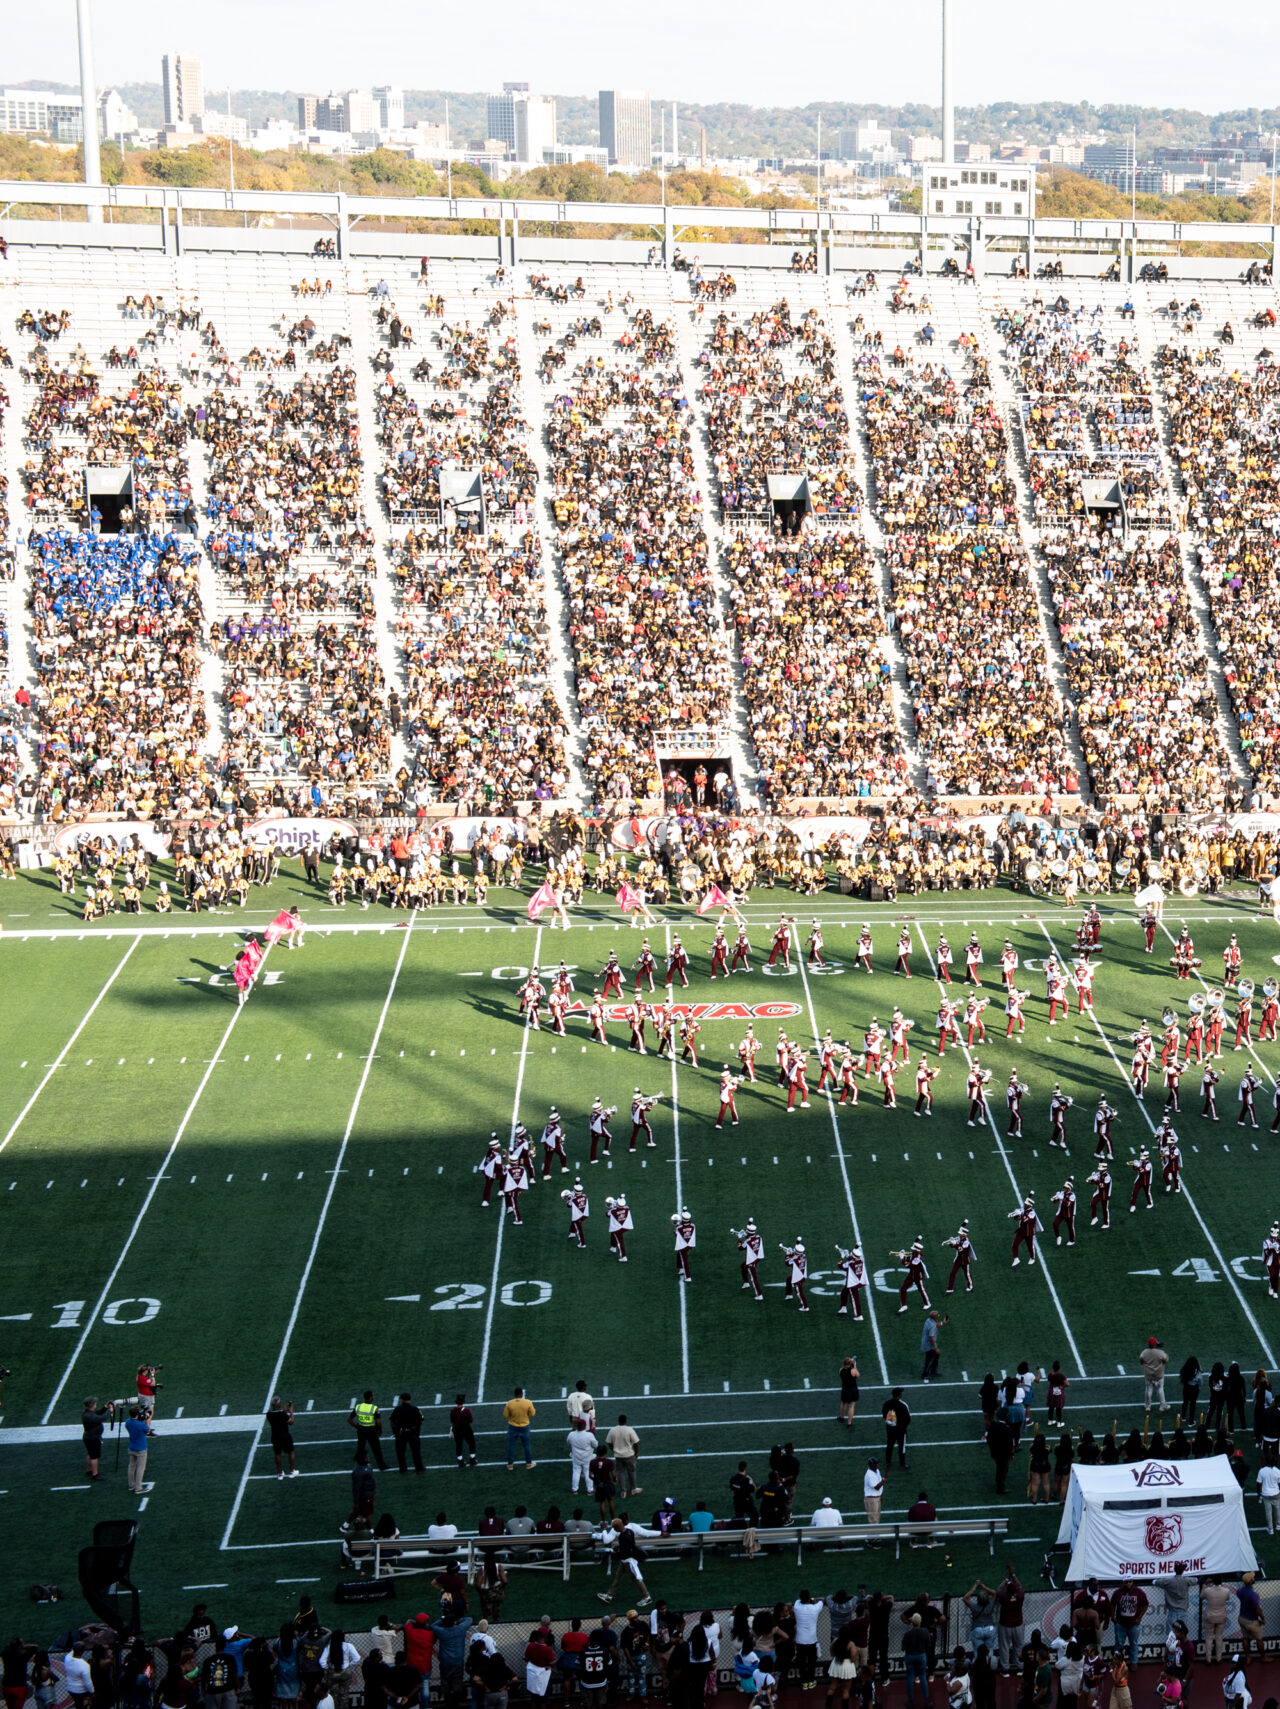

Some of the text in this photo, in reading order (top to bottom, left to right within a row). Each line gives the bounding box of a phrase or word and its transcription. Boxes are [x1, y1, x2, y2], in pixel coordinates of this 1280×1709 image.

[265, 827, 321, 847] Shipt
[429, 1280, 553, 1311] 20
[808, 1267, 920, 1296] 30
[49, 1297, 162, 1328] 10
[1119, 1557, 1206, 1575] SPORTS MECINE
